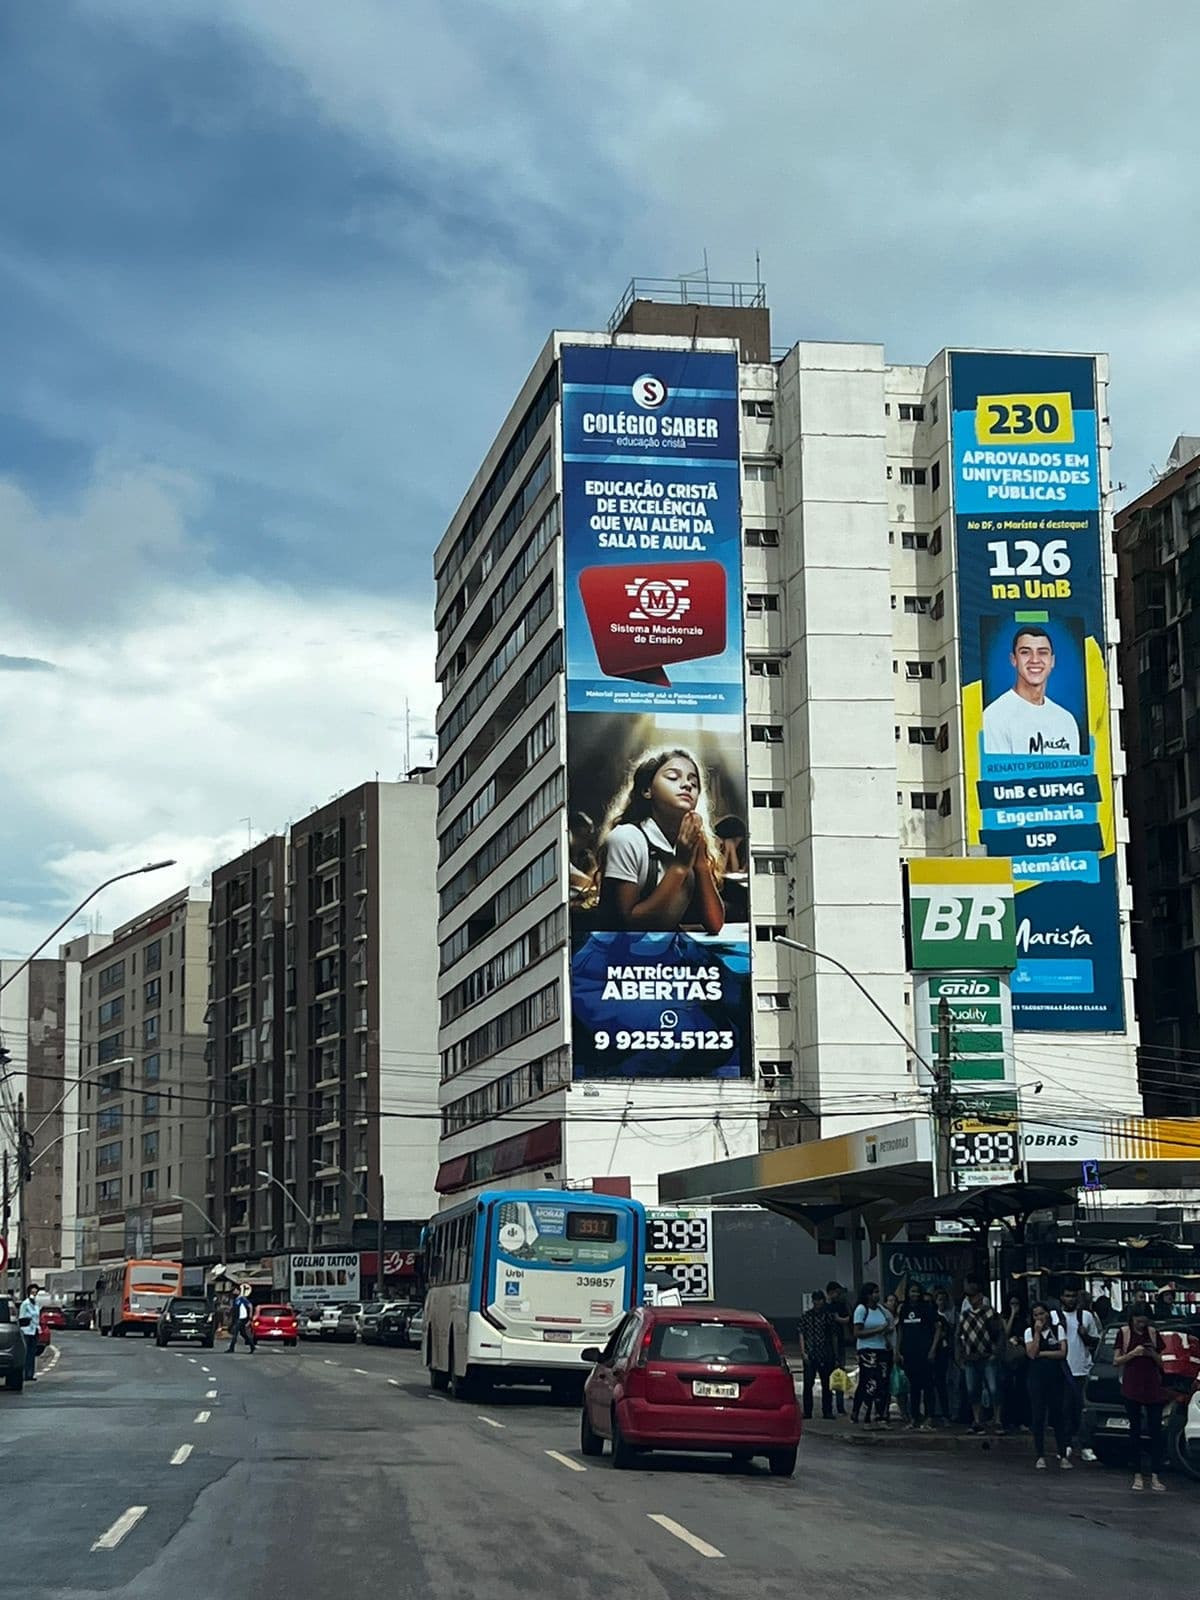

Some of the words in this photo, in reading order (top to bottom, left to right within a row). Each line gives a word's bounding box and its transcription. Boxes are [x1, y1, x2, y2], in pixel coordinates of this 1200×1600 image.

[643, 382, 657, 401] S
[583, 411, 657, 436] COLÉGIO
[661, 417, 718, 438] SABER
[988, 404, 1059, 434] 230
[616, 437, 660, 449] educação
[662, 438, 686, 448] cristã
[963, 450, 1061, 467] APROVADOS
[1065, 454, 1089, 467] EM
[963, 468, 1090, 484] UNIVERSIDADES
[585, 480, 664, 499] EDUCAÇÃO
[667, 482, 718, 500] CRISTÃ
[988, 482, 1067, 500] PÚBLICAS
[597, 499, 616, 513] DE
[620, 499, 707, 516] EXCELÊNCIA
[590, 516, 620, 530] QUE
[623, 518, 648, 531] VAI
[651, 516, 690, 533] ALÉM
[694, 520, 714, 534] DA
[967, 521, 980, 529] No
[1004, 520, 1038, 529] Marista
[1047, 520, 1089, 530] destaque!
[599, 534, 636, 548] SALA
[640, 536, 659, 549] DE
[663, 536, 706, 550] AULA.
[987, 540, 1071, 576] 126
[992, 584, 1021, 599] na
[1025, 580, 1071, 598] UnB
[610, 623, 650, 634] Sistema
[652, 624, 704, 636] Mackenzie
[634, 635, 646, 644] de
[649, 635, 683, 645] Ensino
[988, 763, 1025, 773] RENATO
[1027, 761, 1059, 771] PEDRO
[994, 784, 1025, 800] UnB
[1028, 787, 1037, 798] e
[1040, 782, 1085, 797] UFMG
[996, 807, 1084, 826] Engenharia
[1026, 834, 1057, 848] USP
[1012, 857, 1087, 874] atemática
[921, 896, 1006, 941] BR
[607, 963, 720, 980] MATRÍCULAS
[601, 981, 722, 1001] ABERTAS
[938, 979, 991, 996] GRID
[594, 1031, 610, 1050] 9
[616, 1031, 734, 1050] 9253.5123
[879, 1137, 909, 1152] PETROBRAS
[950, 1132, 1014, 1164] 5.89
[1024, 1135, 1079, 1147] OBRAS
[653, 1220, 706, 1249] 3.99
[292, 1256, 325, 1267] COELHO
[327, 1255, 358, 1266] TATTOO
[506, 1270, 524, 1278] Urbi
[576, 1276, 616, 1288] 339857
